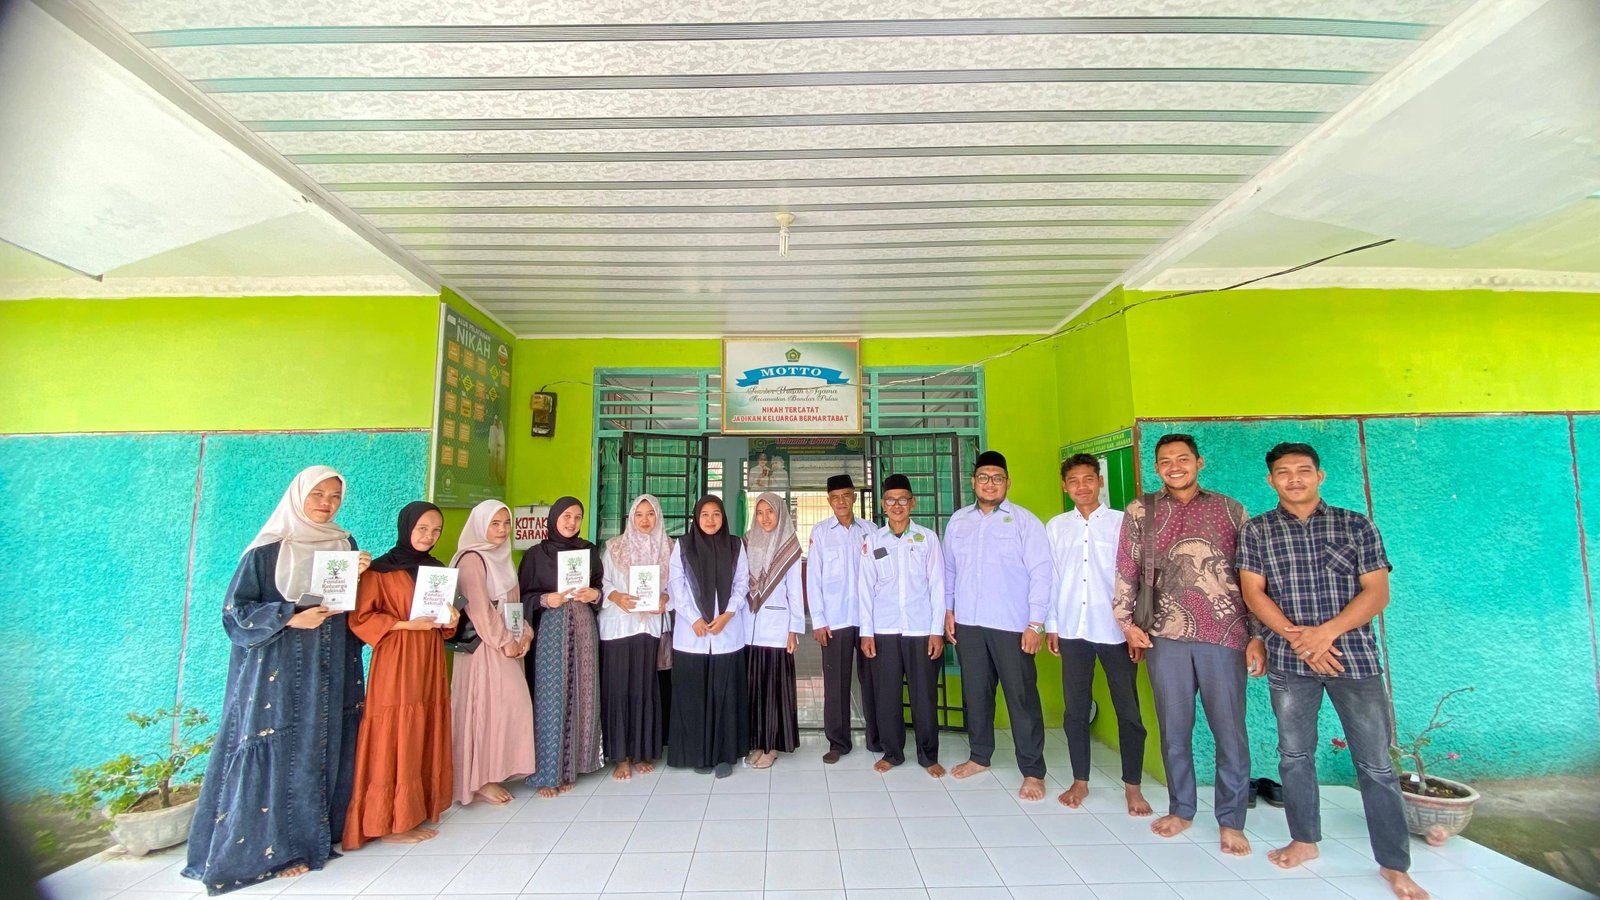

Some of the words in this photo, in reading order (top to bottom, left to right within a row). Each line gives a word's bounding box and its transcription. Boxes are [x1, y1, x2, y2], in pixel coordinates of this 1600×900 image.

[457, 325, 490, 359] NIKAH
[760, 367, 822, 377] MOTTO
[515, 517, 548, 529] KOTAK
[515, 530, 549, 540] SARAN
